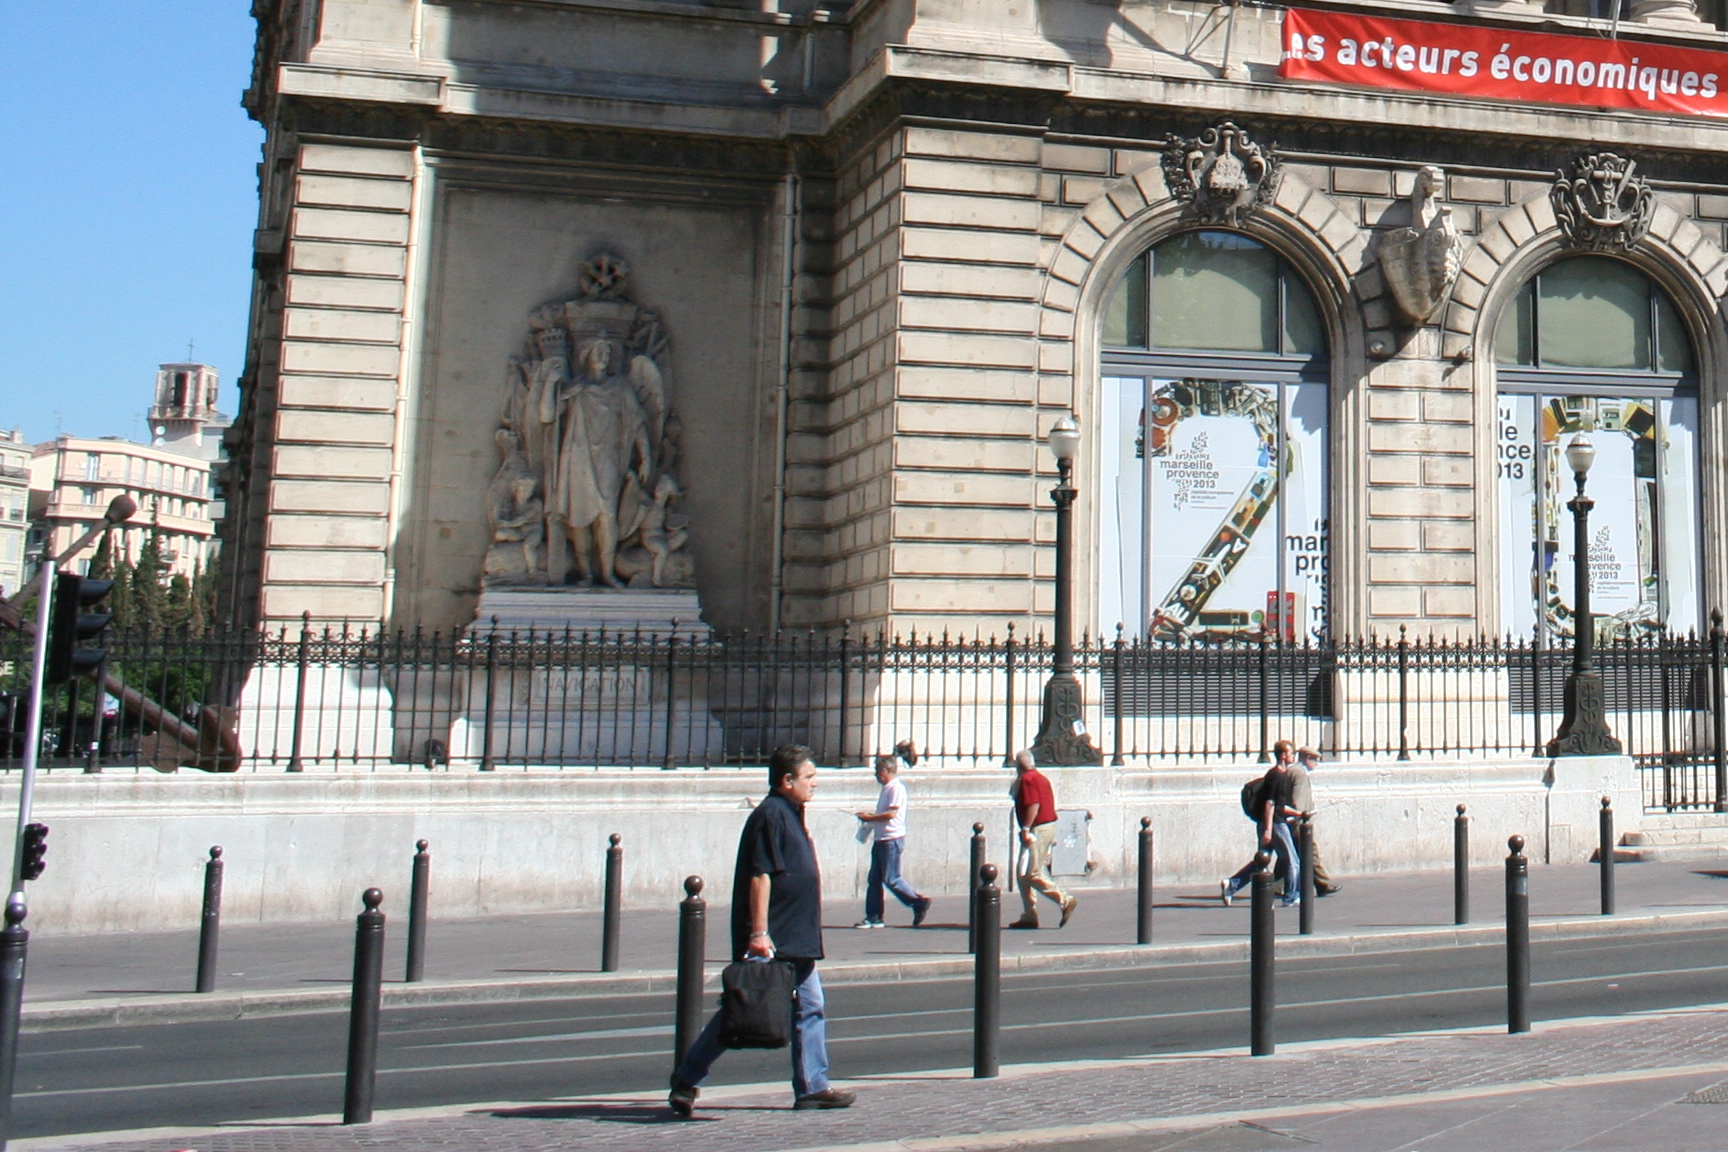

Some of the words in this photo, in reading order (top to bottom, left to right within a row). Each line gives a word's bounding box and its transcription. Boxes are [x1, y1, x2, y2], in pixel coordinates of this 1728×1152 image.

[1282, 32, 1325, 62] es
[1337, 37, 1478, 77] acteurs
[1491, 43, 1718, 101] économiques
[1160, 460, 1213, 469] marseille
[1166, 470, 1220, 479] provence
[1193, 480, 1216, 488] 2013
[543, 676, 637, 693] NAVIGATION
